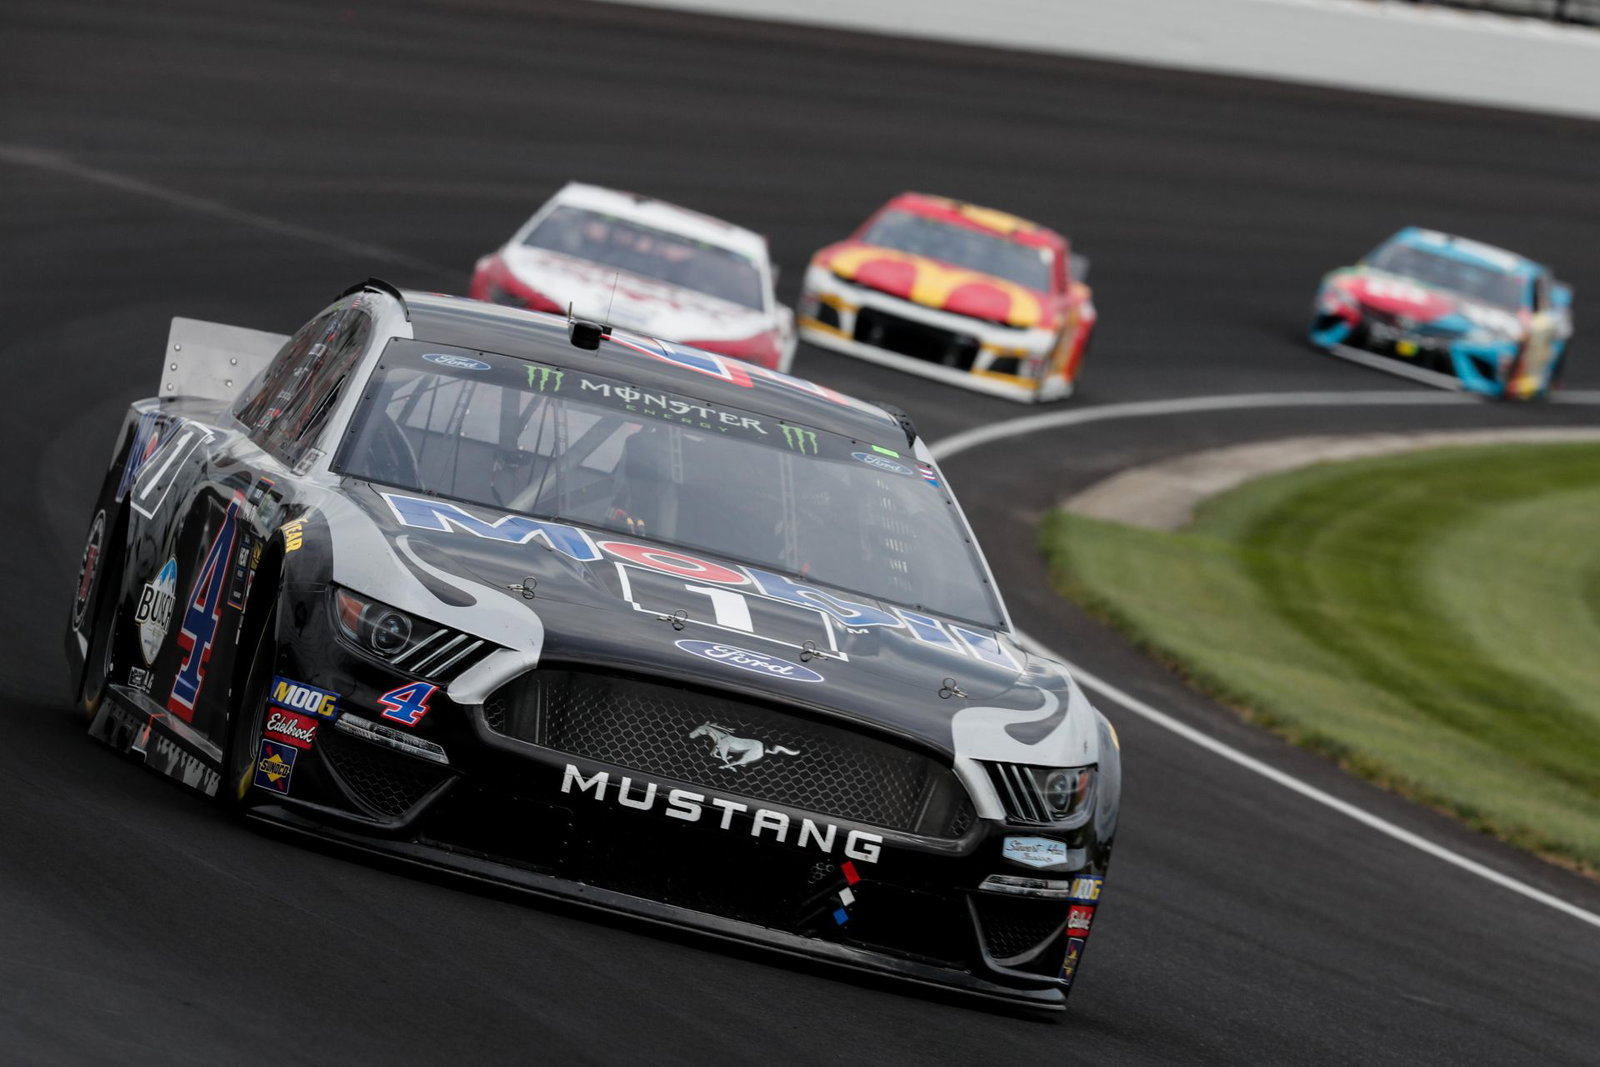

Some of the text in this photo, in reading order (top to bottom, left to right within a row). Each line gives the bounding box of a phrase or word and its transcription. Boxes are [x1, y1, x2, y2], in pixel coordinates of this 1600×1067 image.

[434, 355, 480, 369] Ford
[580, 379, 768, 434] MONSTER
[626, 404, 728, 433] ENERGY
[863, 455, 902, 473] Ford
[380, 492, 1026, 675] Mobil
[136, 583, 177, 634] BUSCH
[167, 487, 245, 724] 4
[684, 584, 755, 633] 1
[704, 643, 796, 677] Ford
[272, 681, 337, 718] MOOG
[376, 680, 442, 728] 4
[266, 712, 315, 743] Edelbrock
[260, 759, 290, 777] SUNOCO
[560, 763, 884, 864] MUSTANG
